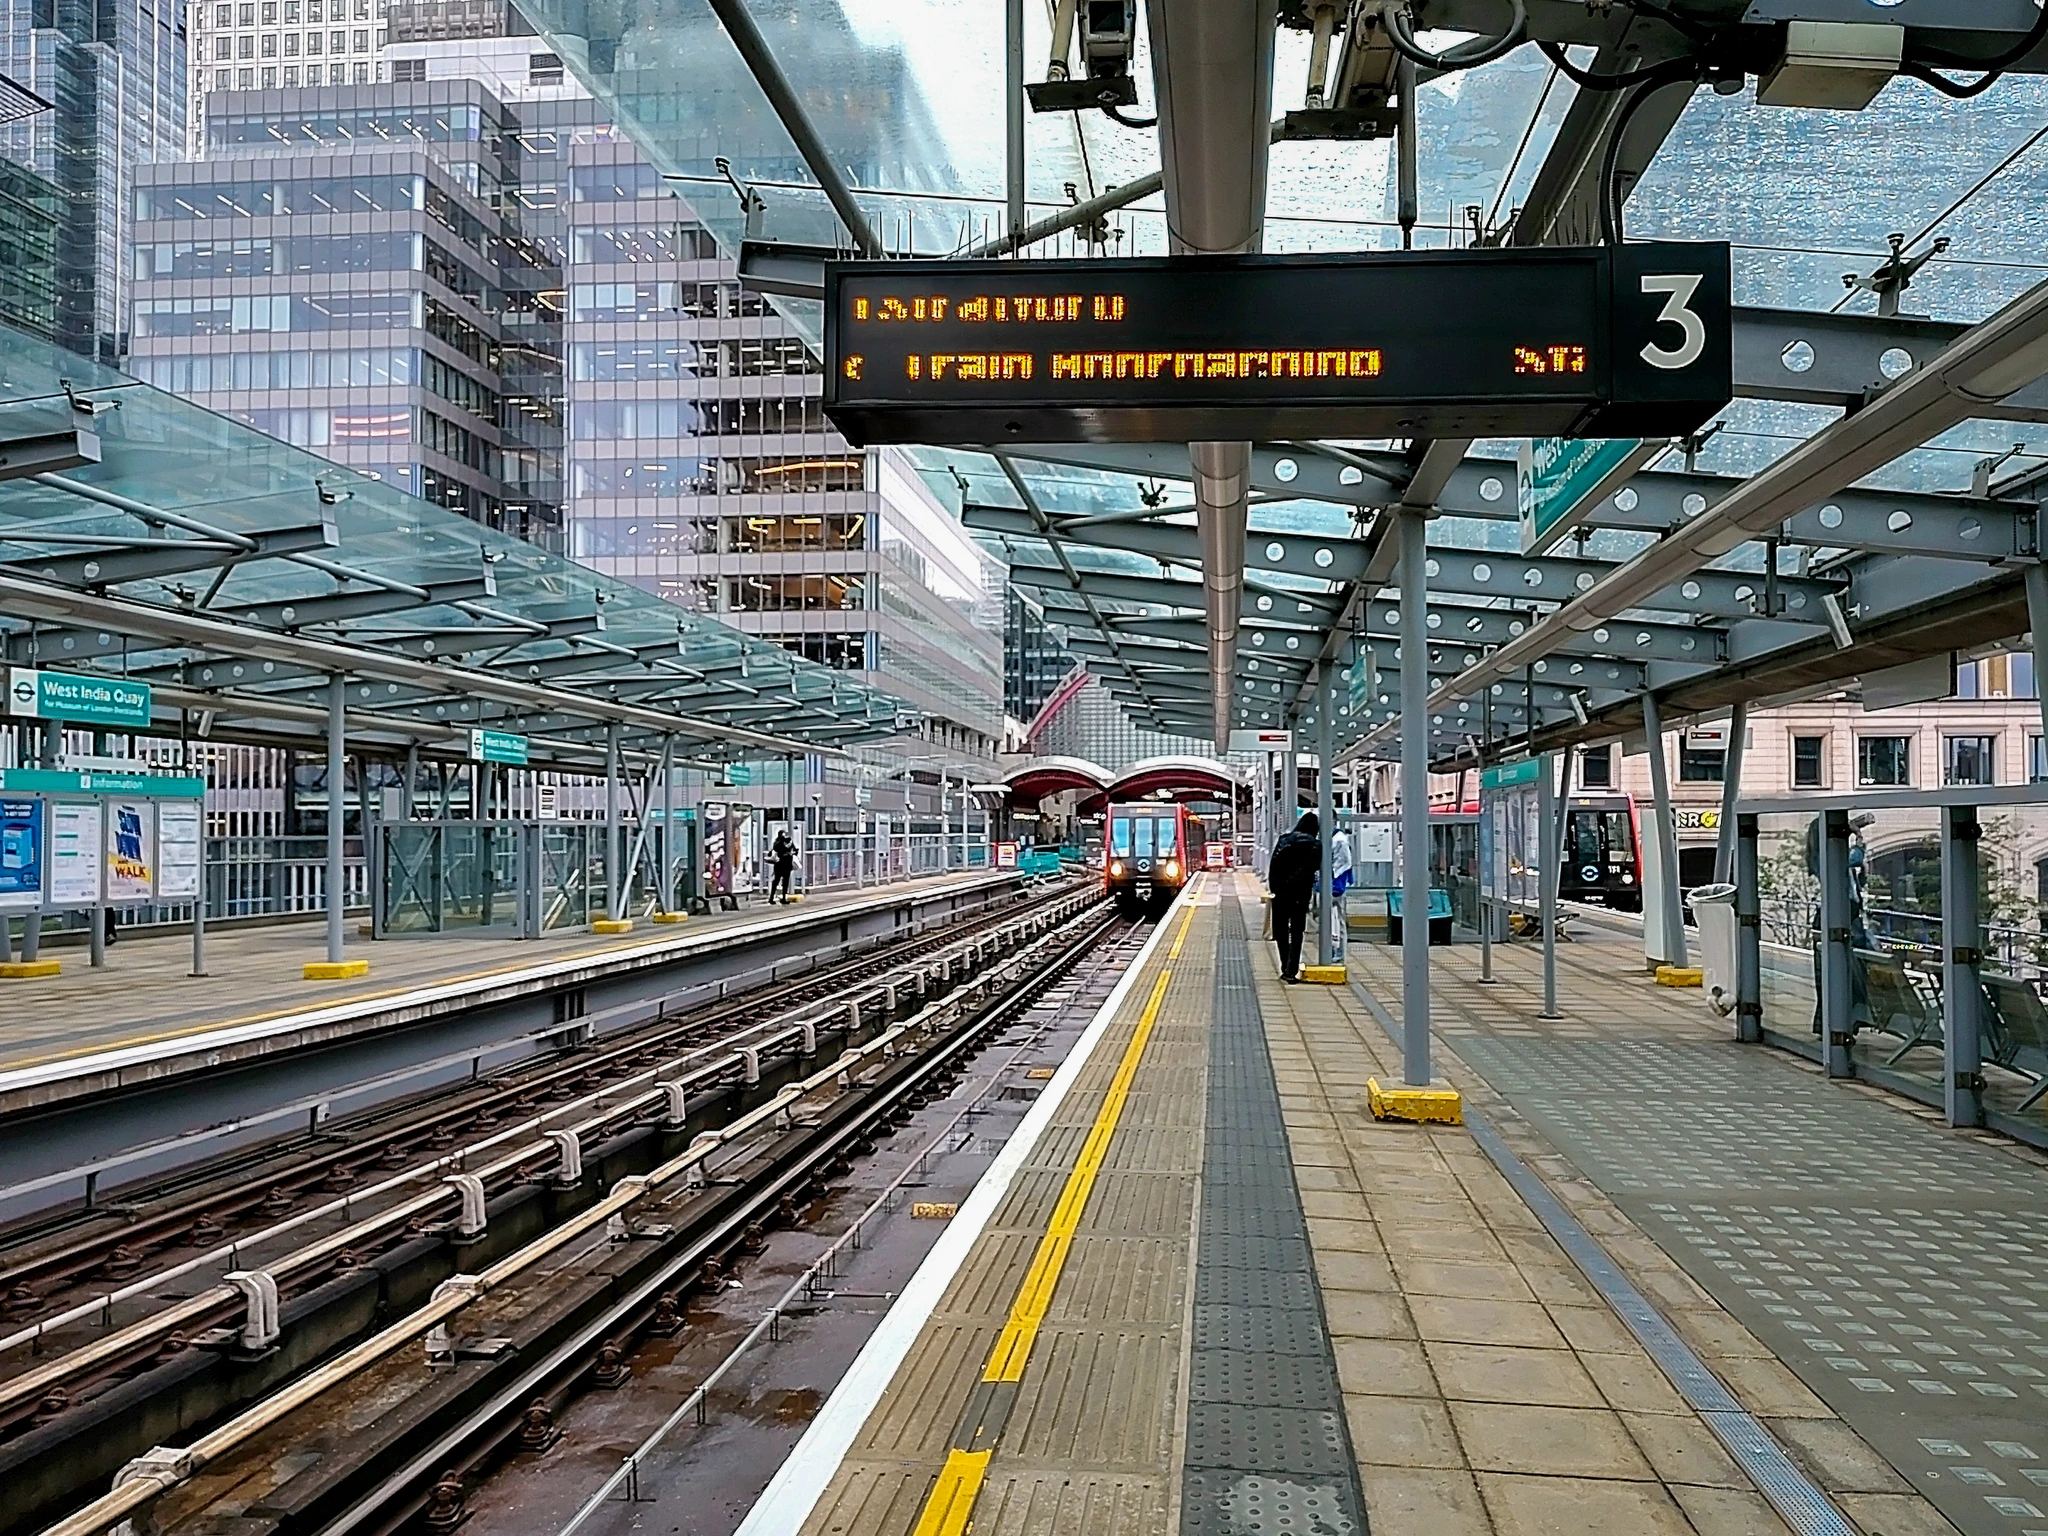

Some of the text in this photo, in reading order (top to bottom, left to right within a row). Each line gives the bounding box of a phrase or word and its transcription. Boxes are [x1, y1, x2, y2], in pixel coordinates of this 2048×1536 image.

[1639, 274, 1706, 369] 3
[43, 681, 145, 708] West India Quay
